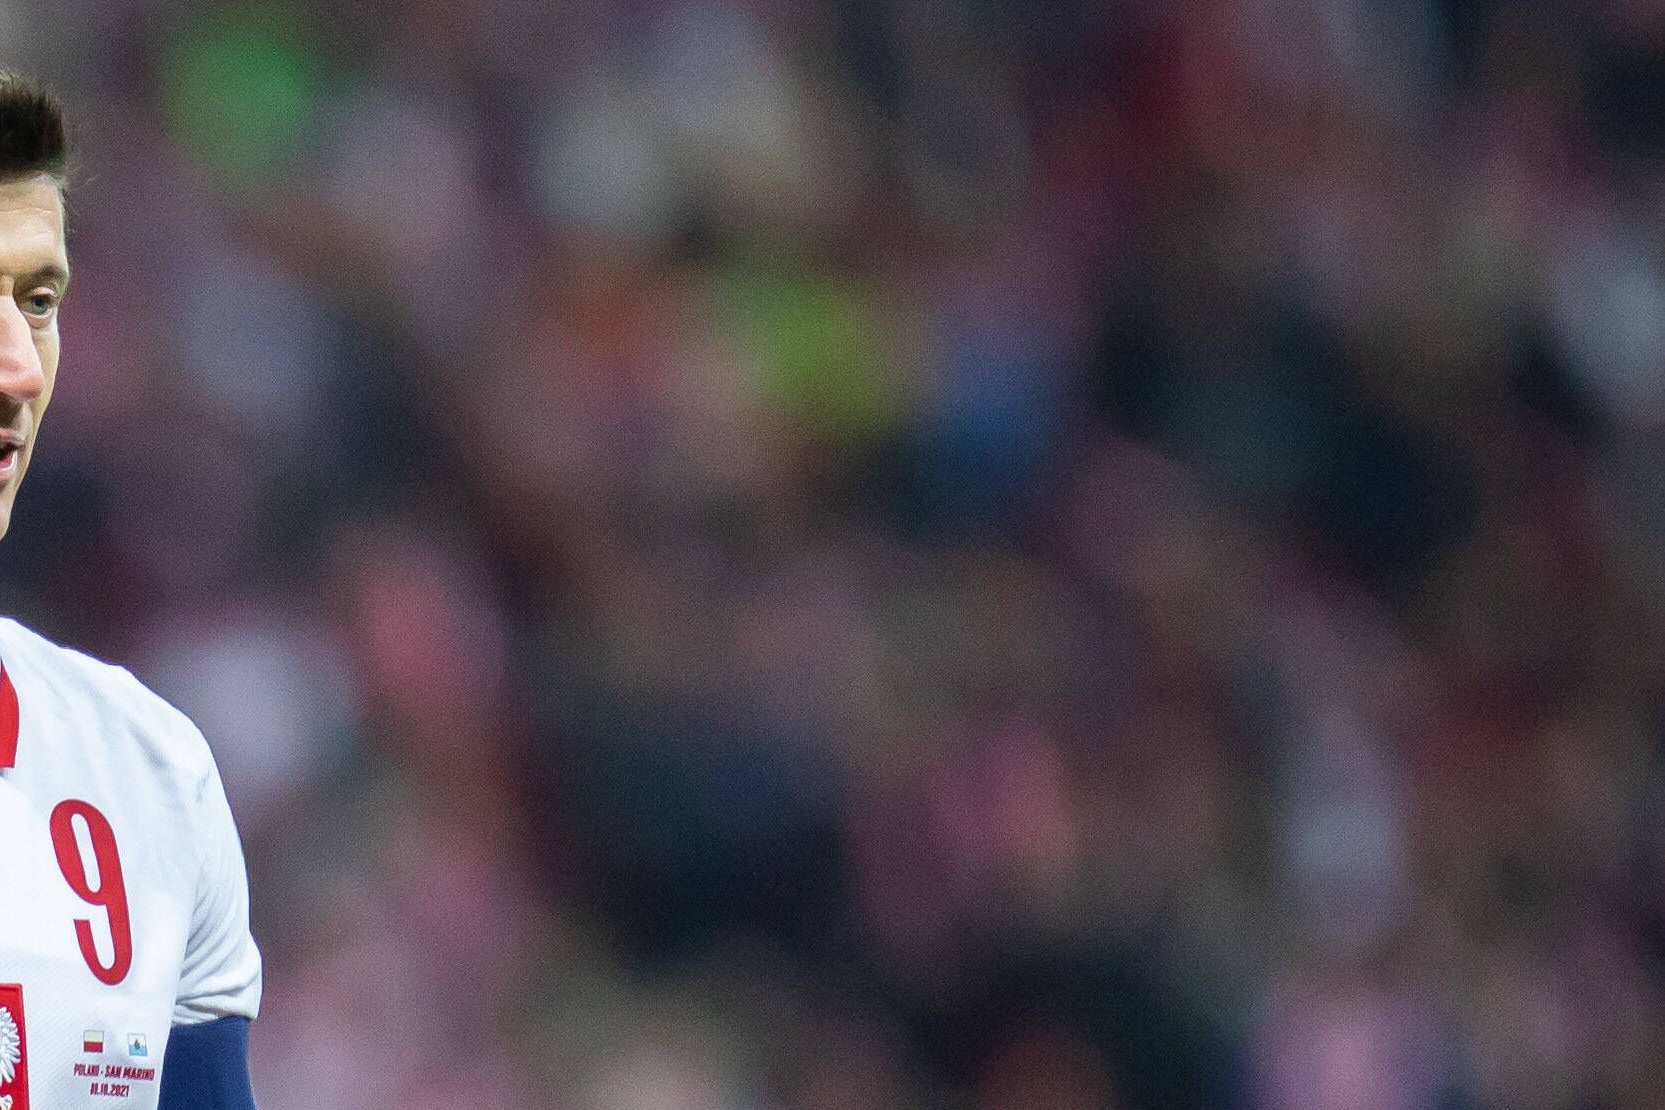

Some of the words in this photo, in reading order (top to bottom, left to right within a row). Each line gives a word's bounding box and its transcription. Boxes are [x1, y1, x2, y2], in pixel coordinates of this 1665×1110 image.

[49, 799, 133, 986] 9
[74, 1063, 100, 1077] POLAND
[105, 1065, 122, 1079] SAN
[122, 1067, 155, 1081] MARINO
